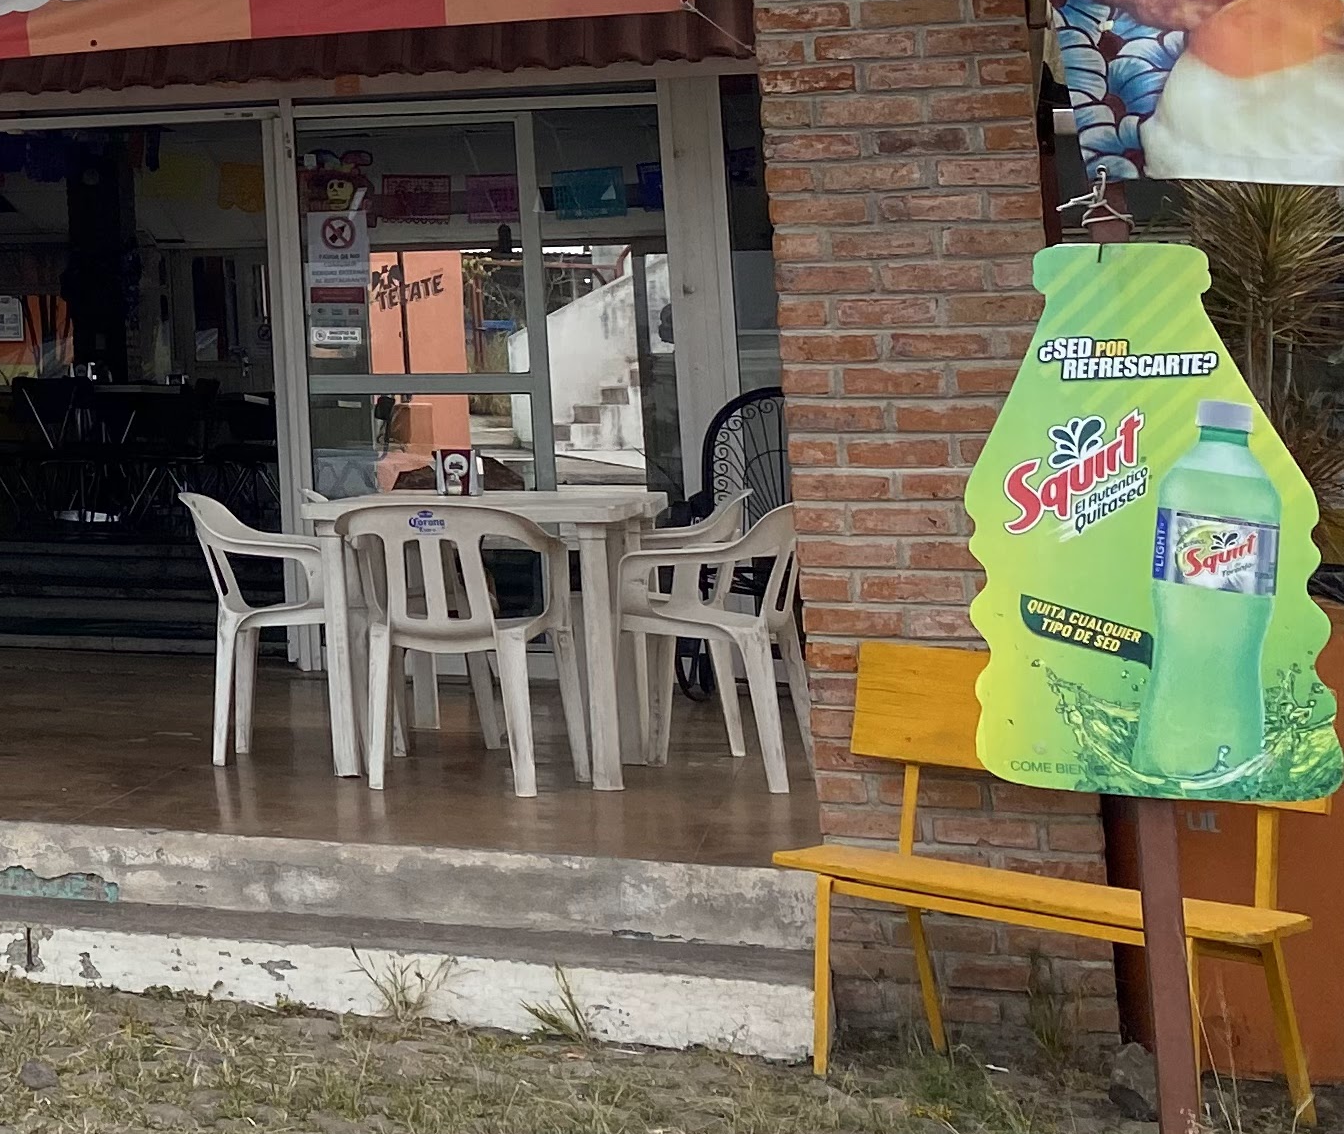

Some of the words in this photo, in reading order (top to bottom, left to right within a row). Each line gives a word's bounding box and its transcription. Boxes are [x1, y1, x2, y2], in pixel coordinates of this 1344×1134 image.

[1039, 338, 1093, 362] ¿SED
[1094, 340, 1129, 358] POR
[1062, 352, 1218, 380] REFRESCARTE?
[1005, 411, 1144, 533] Squirt
[408, 517, 445, 528] Corona
[1075, 479, 1148, 534] Quitased
[1075, 499, 1088, 516] El
[1184, 532, 1257, 577] Squirt
[1027, 599, 1066, 621] QUITA
[1068, 612, 1142, 644] CUALQUIER
[1041, 617, 1074, 638] TIPO
[1074, 628, 1094, 645] DE
[1093, 634, 1121, 653] SED
[1010, 760, 1053, 774] COME
